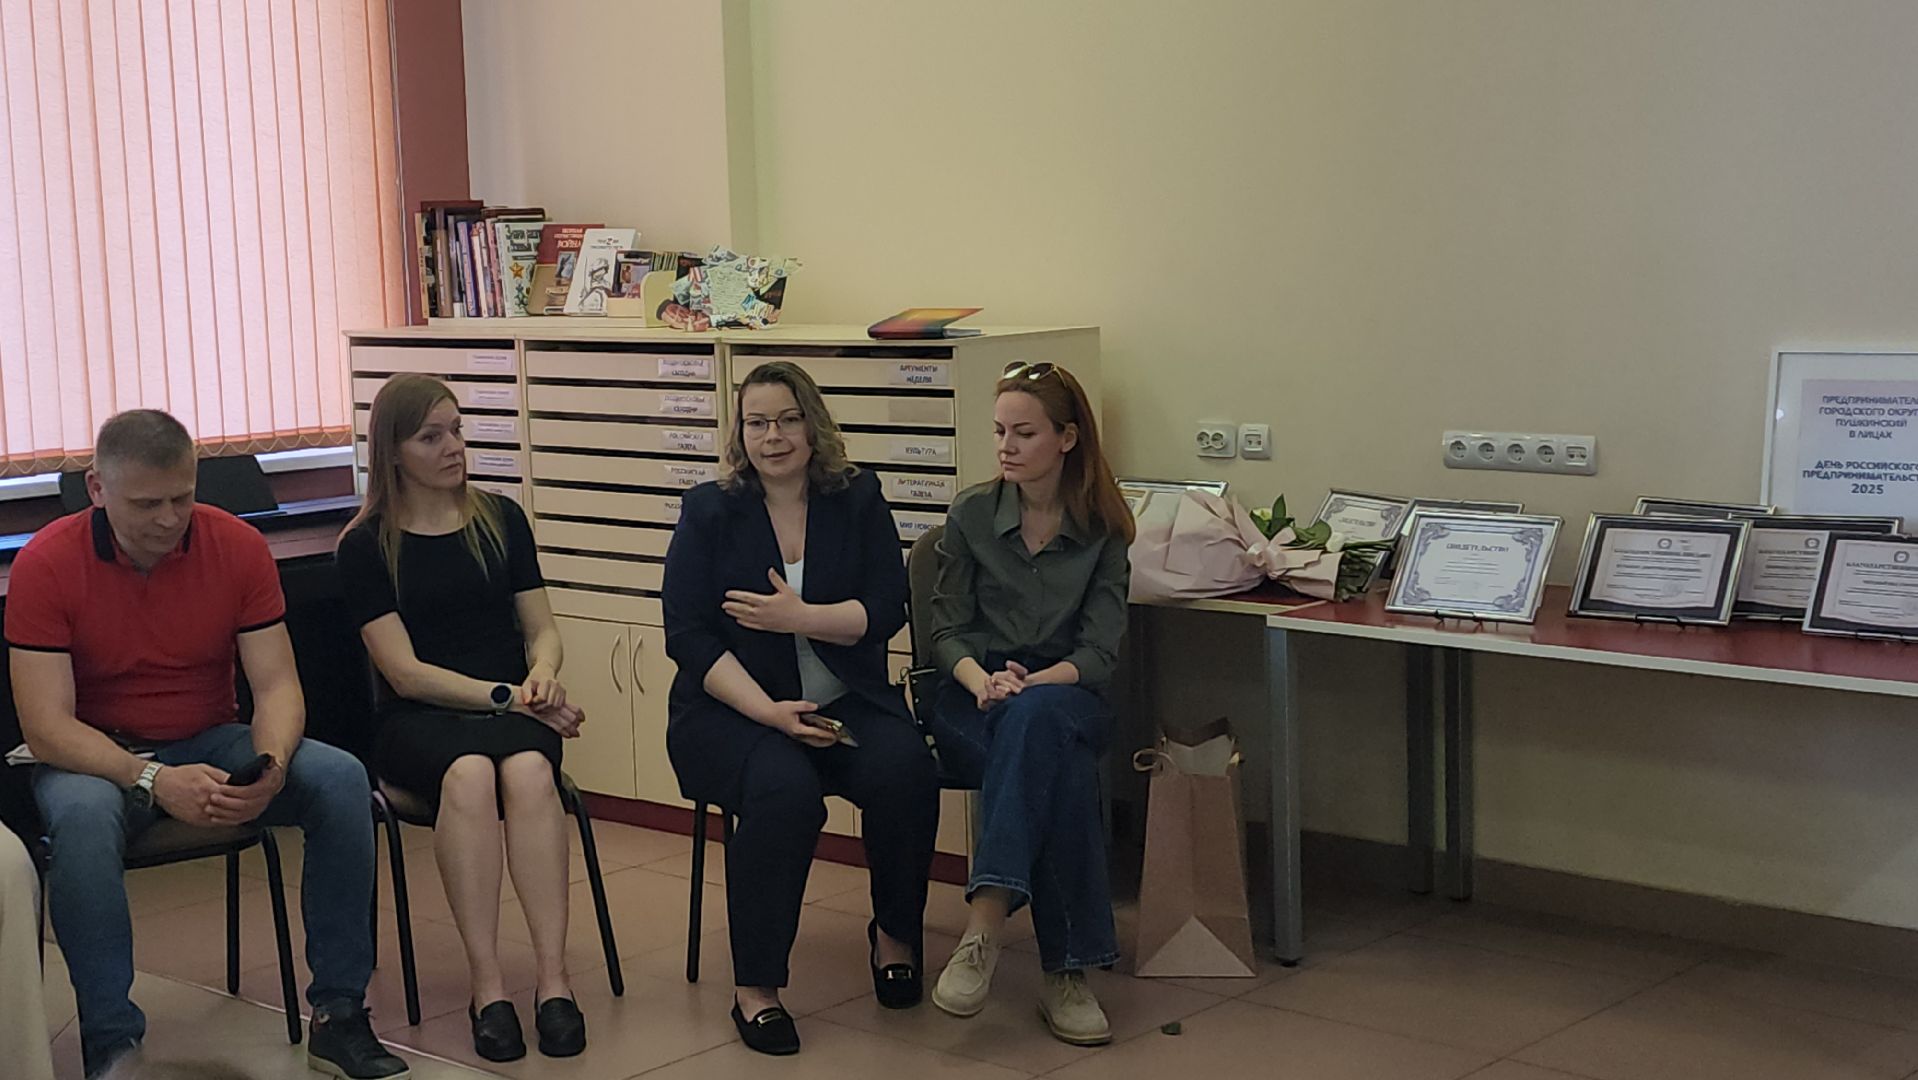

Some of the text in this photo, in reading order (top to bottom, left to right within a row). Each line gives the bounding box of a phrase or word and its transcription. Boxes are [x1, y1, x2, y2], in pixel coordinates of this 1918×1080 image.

[1819, 406, 1885, 416] ГОРОДСКОГО
[1836, 418, 1907, 428] ПУШКИНСКИЙ
[1849, 430, 1892, 440] В ЛИЦАХ
[1815, 460, 1843, 470] ДЕНЬ
[1851, 483, 1884, 495] 2025
